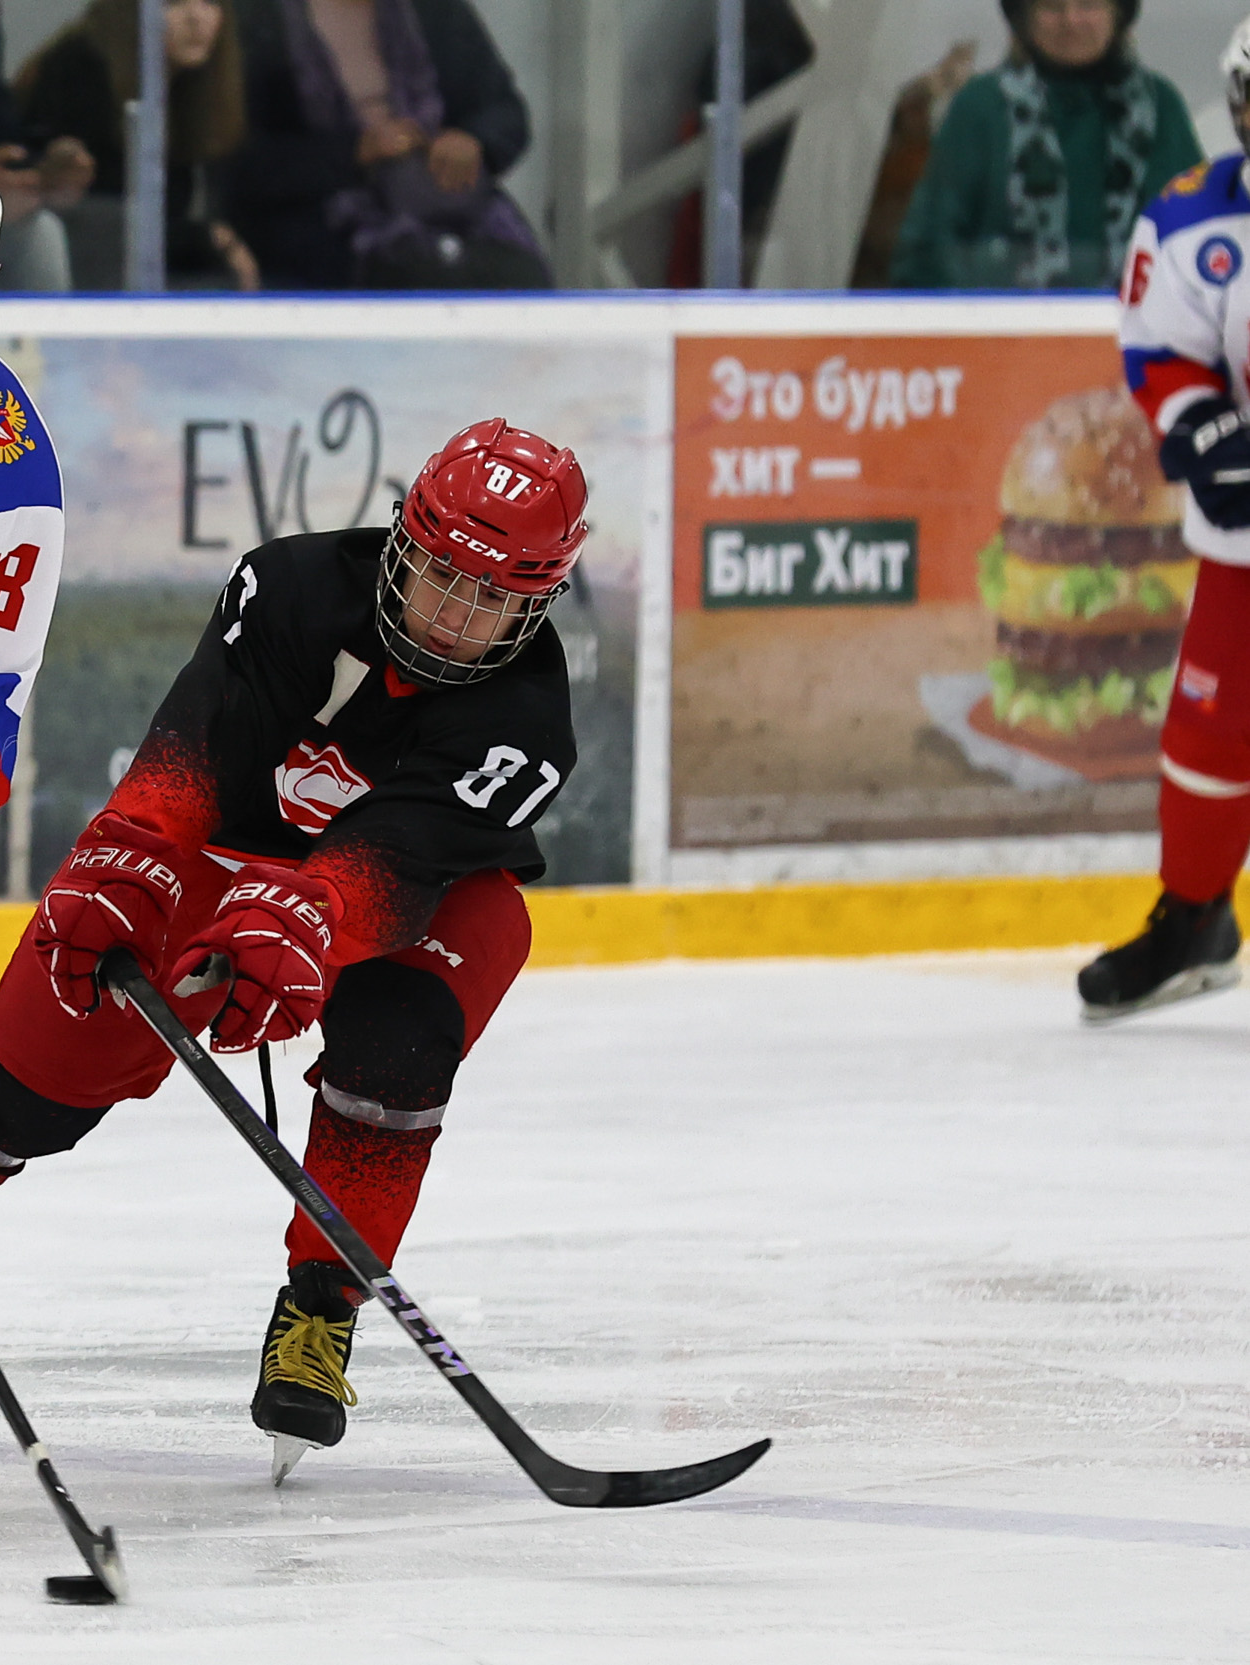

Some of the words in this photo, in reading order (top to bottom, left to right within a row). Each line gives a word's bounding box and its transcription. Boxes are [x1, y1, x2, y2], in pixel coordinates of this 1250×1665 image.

[709, 356, 804, 421] Это
[814, 354, 963, 434] будет
[184, 388, 410, 550] EVO
[486, 464, 532, 501] 87
[449, 529, 508, 562] CCM
[708, 529, 806, 597] Биг
[812, 526, 910, 594] Хит
[452, 744, 561, 828] 87
[370, 1275, 472, 1378] CCM
